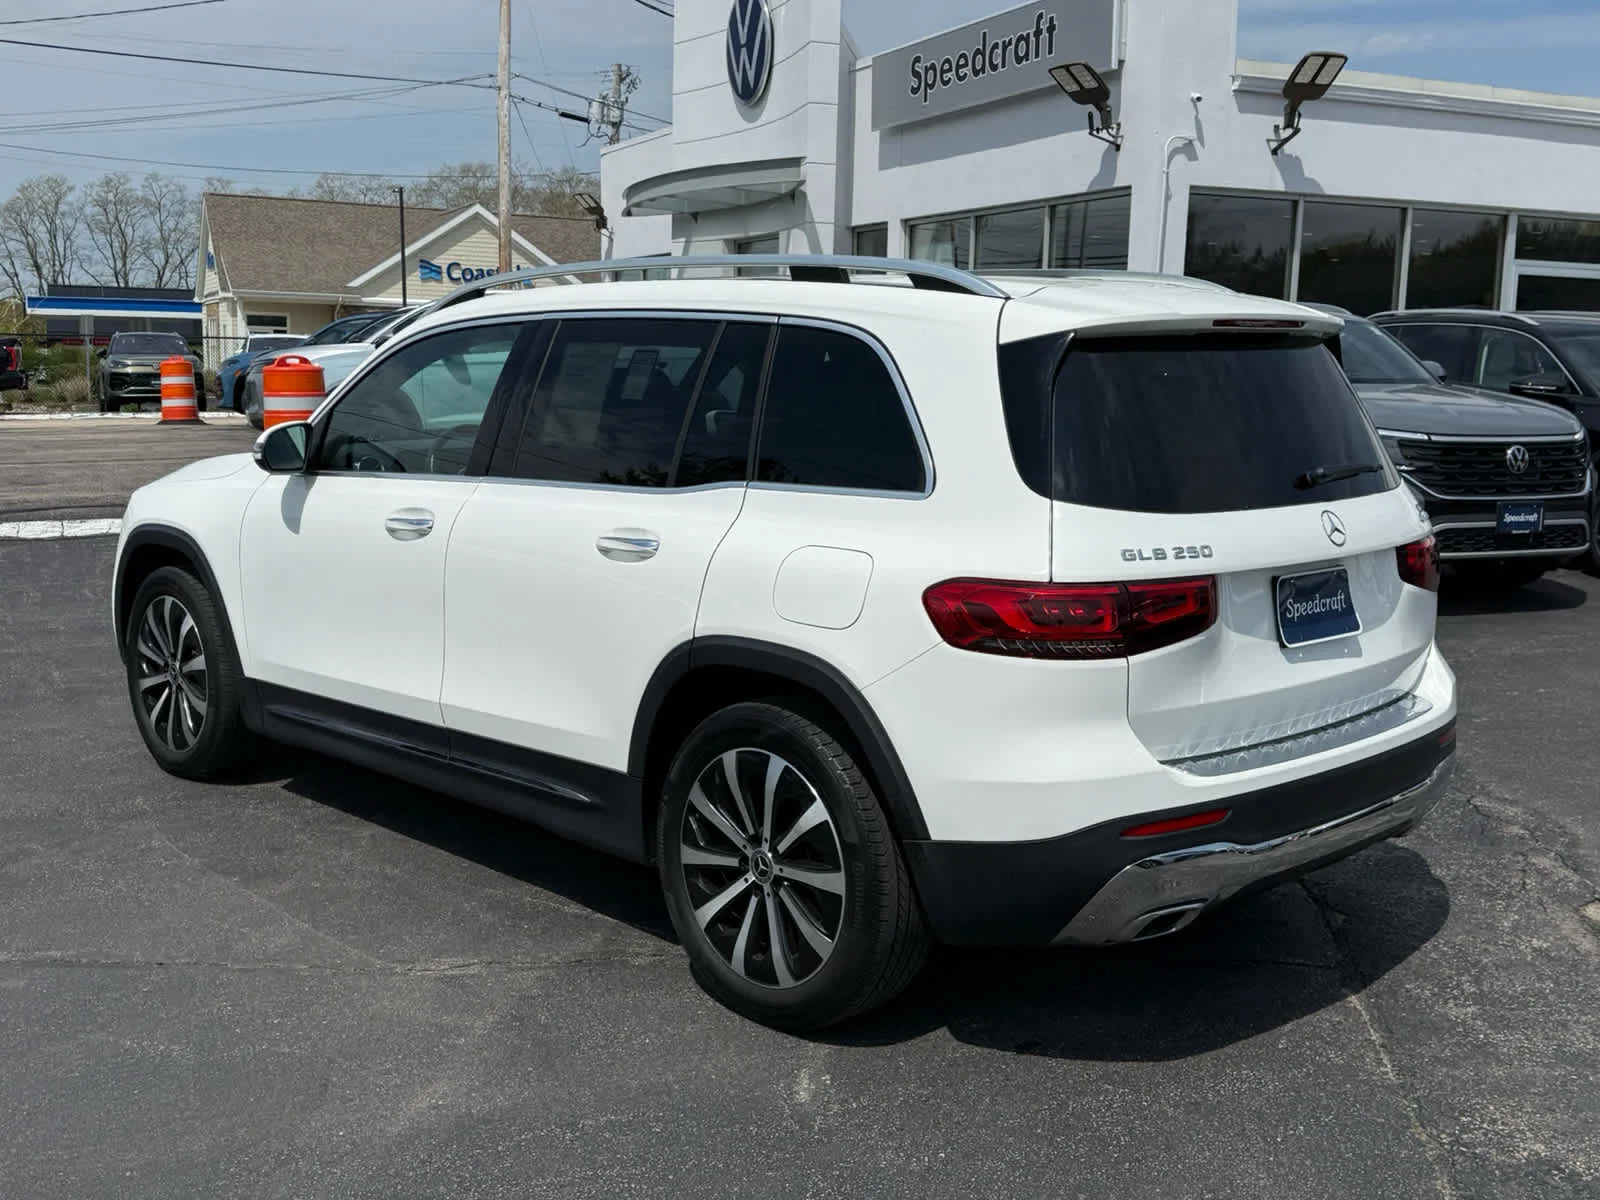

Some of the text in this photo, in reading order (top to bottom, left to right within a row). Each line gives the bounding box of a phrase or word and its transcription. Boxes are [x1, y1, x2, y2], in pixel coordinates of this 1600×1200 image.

[910, 10, 1057, 103] Speedcraft
[1120, 545, 1213, 561] GLB 250
[1286, 589, 1346, 622] Speedcraft
